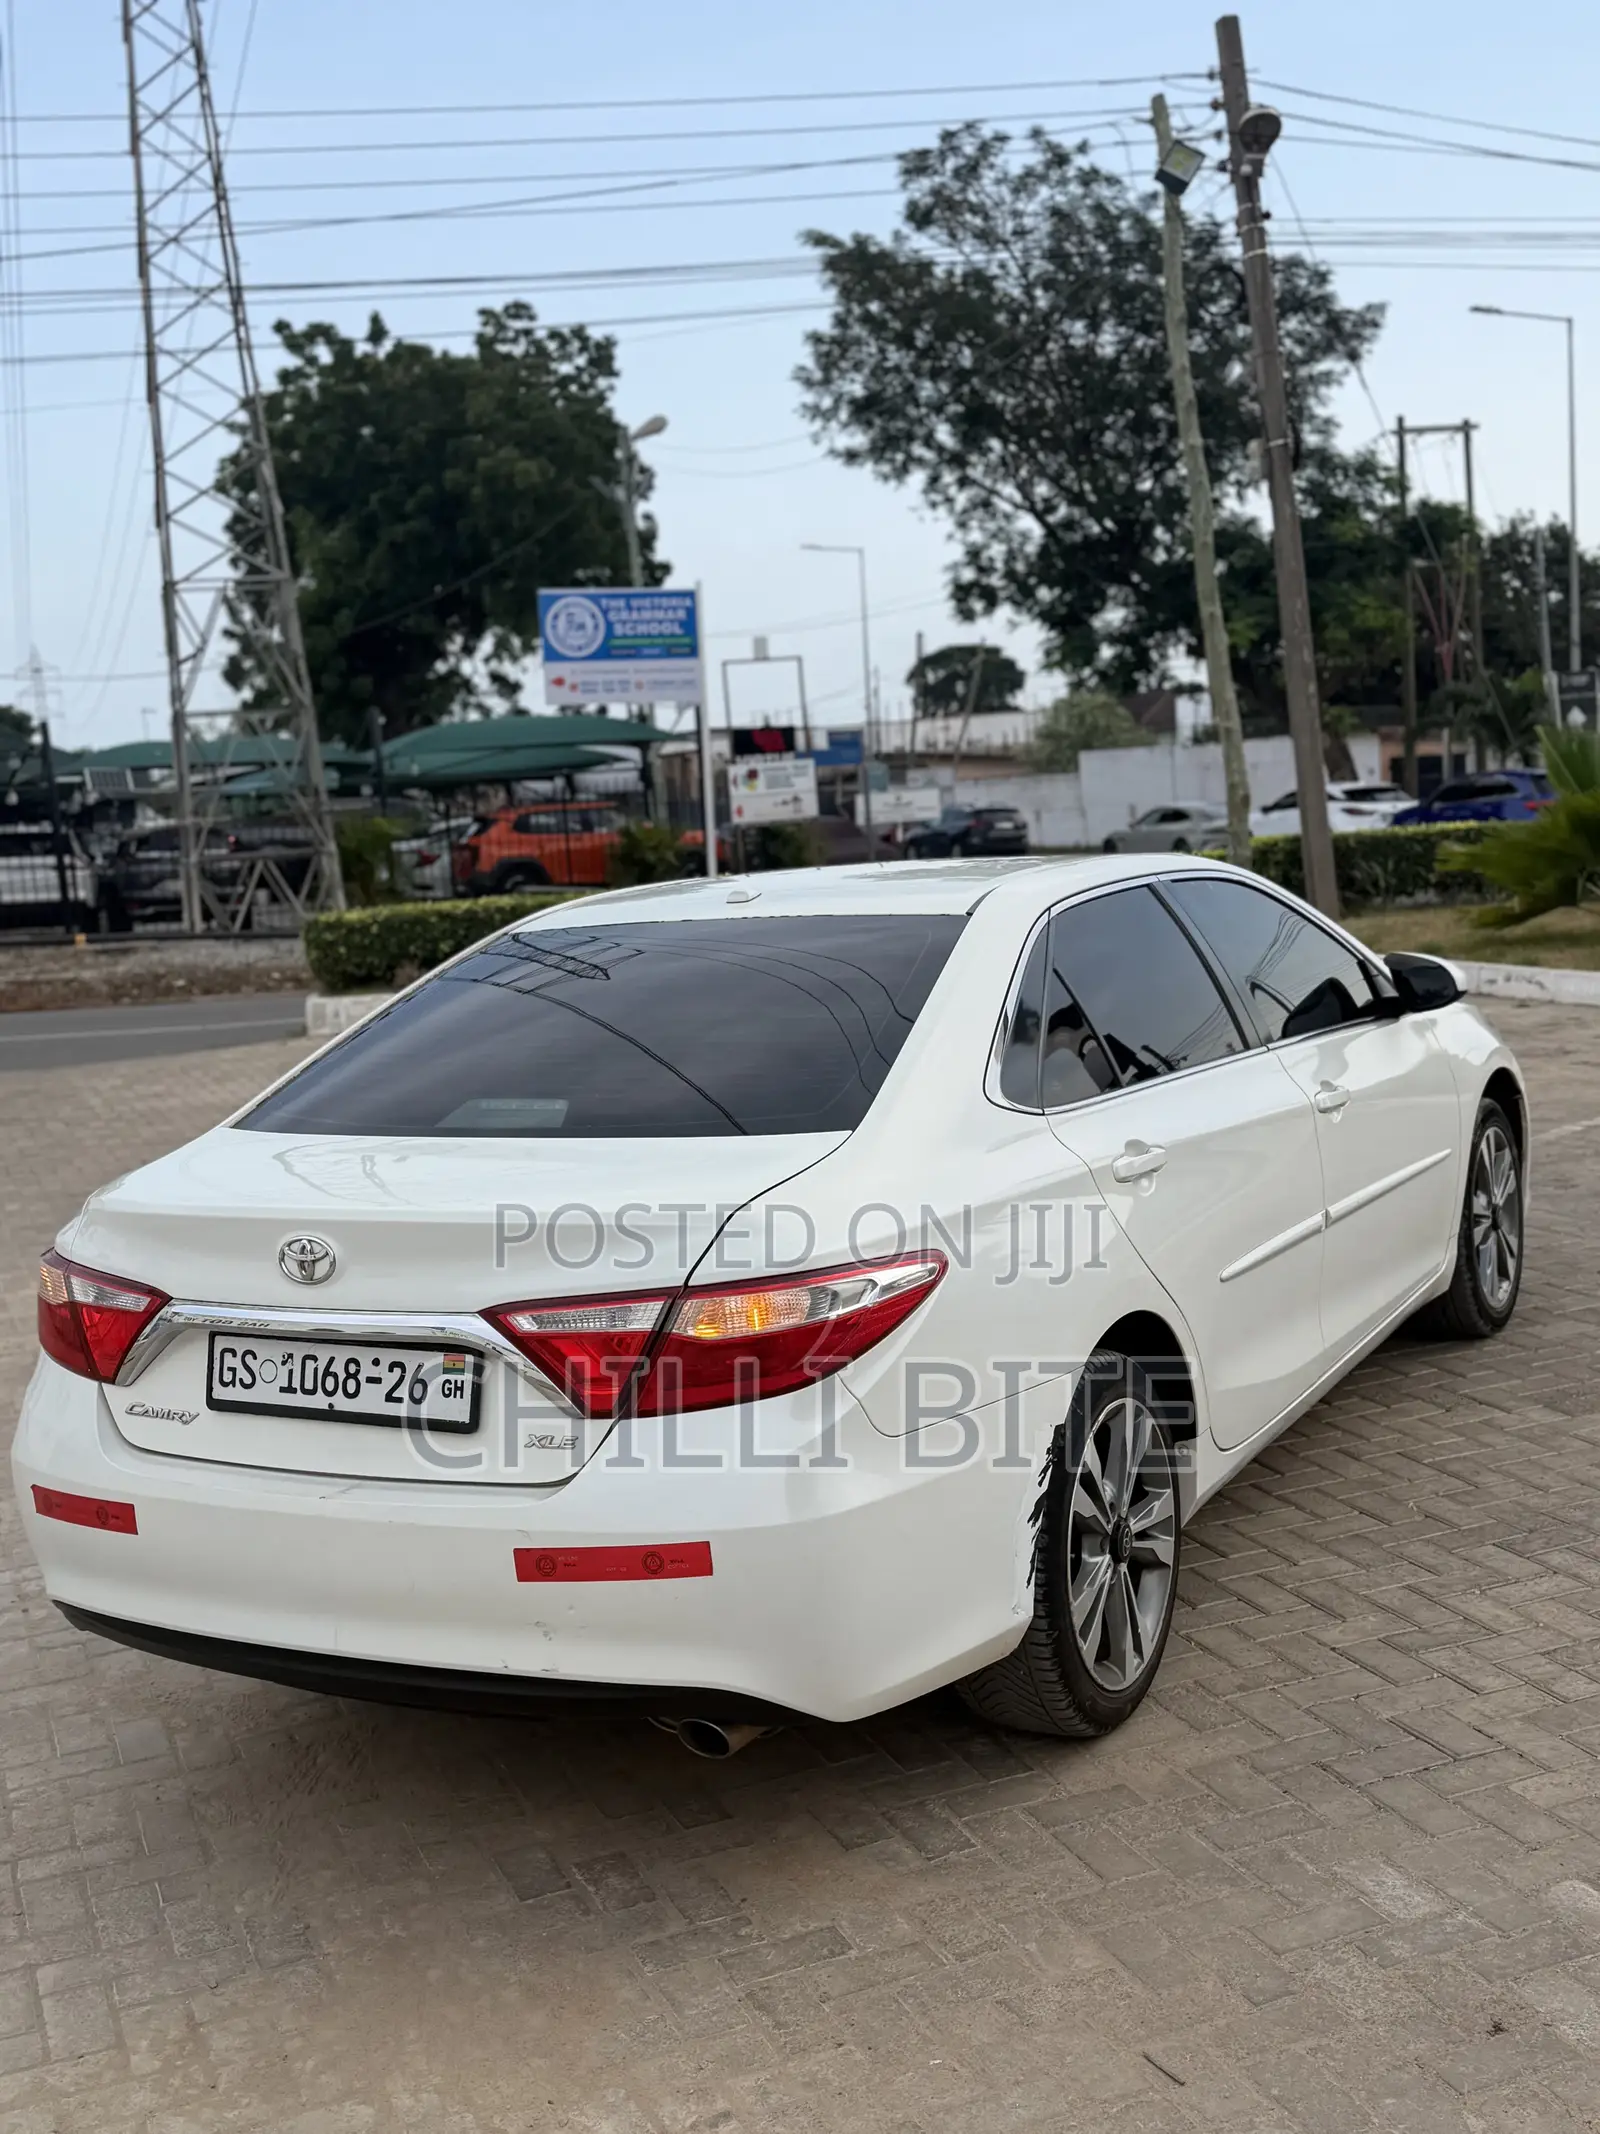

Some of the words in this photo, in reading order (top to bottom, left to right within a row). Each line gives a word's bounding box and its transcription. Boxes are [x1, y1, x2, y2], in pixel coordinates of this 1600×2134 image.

[600, 598, 626, 609] THE
[607, 609, 687, 622] GRAMMAR
[613, 621, 685, 636] SCHOOL
[218, 1347, 258, 1390] GS
[441, 1378, 465, 1400] GH
[124, 1401, 200, 1426] CAMRY
[524, 1434, 579, 1450] XLE
